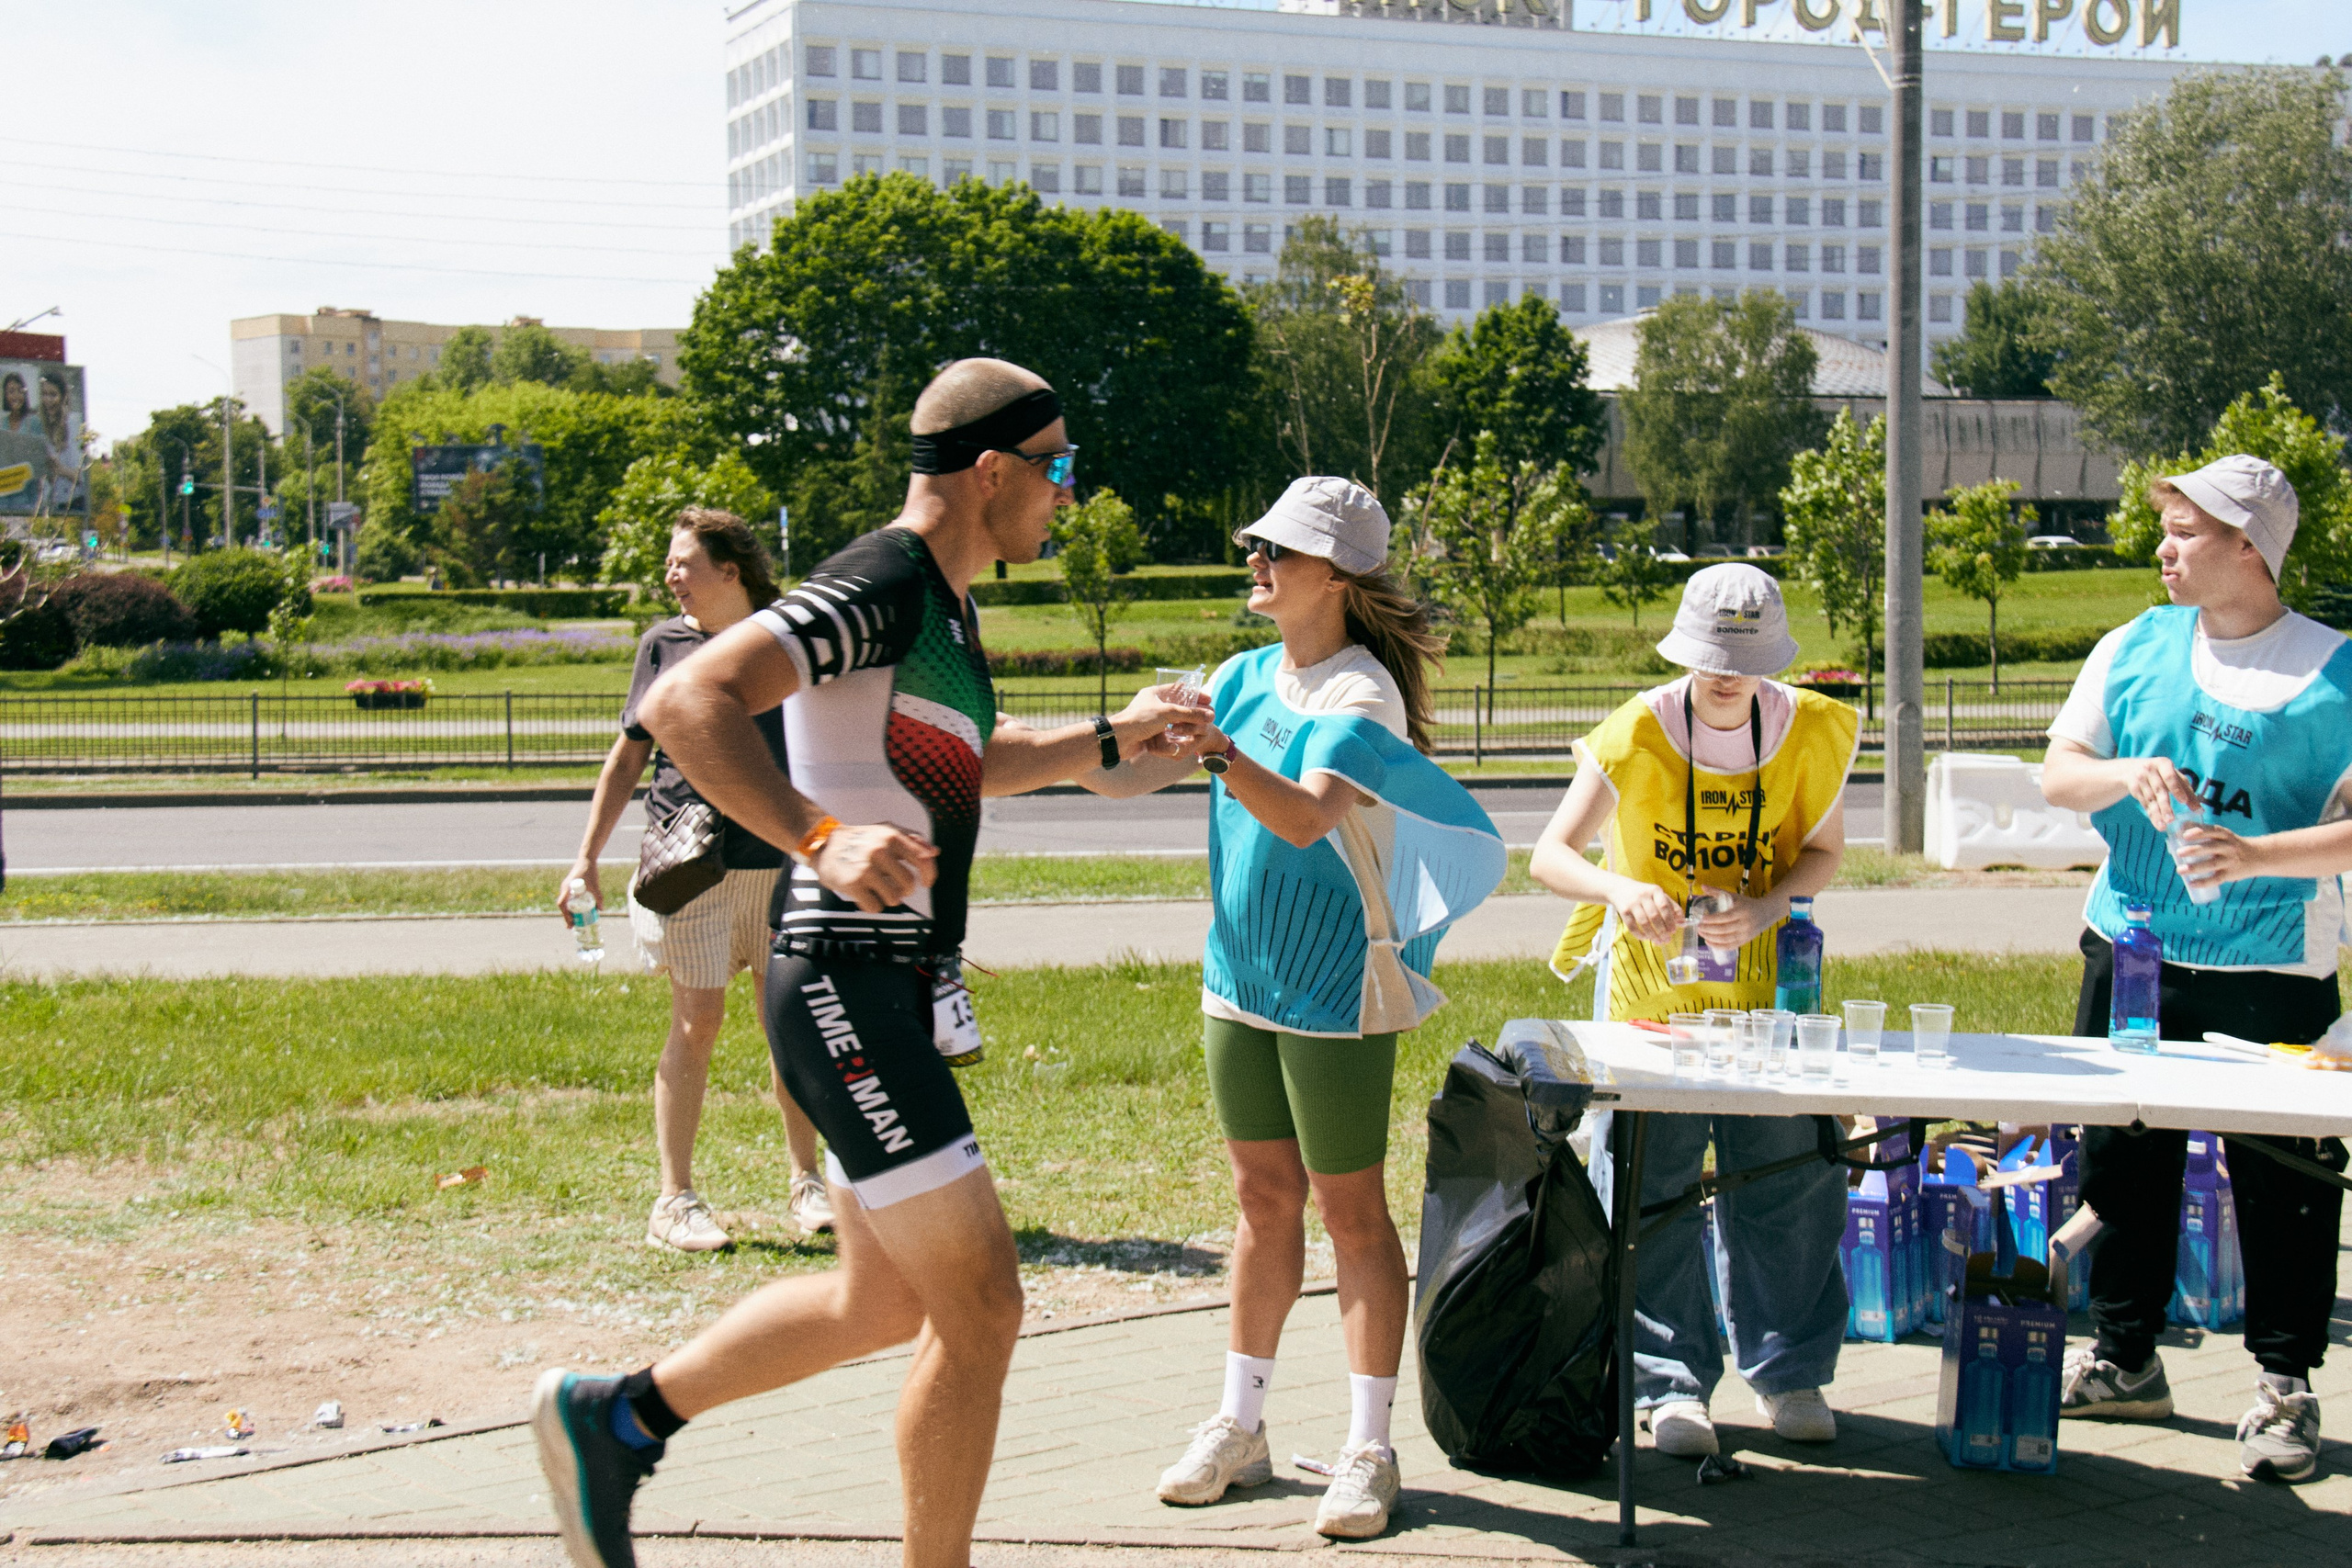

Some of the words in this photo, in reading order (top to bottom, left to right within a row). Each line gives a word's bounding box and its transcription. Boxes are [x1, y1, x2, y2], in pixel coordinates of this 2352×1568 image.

[1744, 610, 1760, 619] STAR
[1716, 626, 1759, 635] ВОЛОНТЁР
[2191, 710, 2215, 729] IRON
[2223, 724, 2253, 745] STAR
[1701, 790, 1727, 804] IRON
[1739, 789, 1766, 804] STR
[800, 975, 914, 1154] TIMERMAN
[1851, 1207, 1880, 1216] PREMIUM
[2020, 1319, 2056, 1329] PREMIUM
